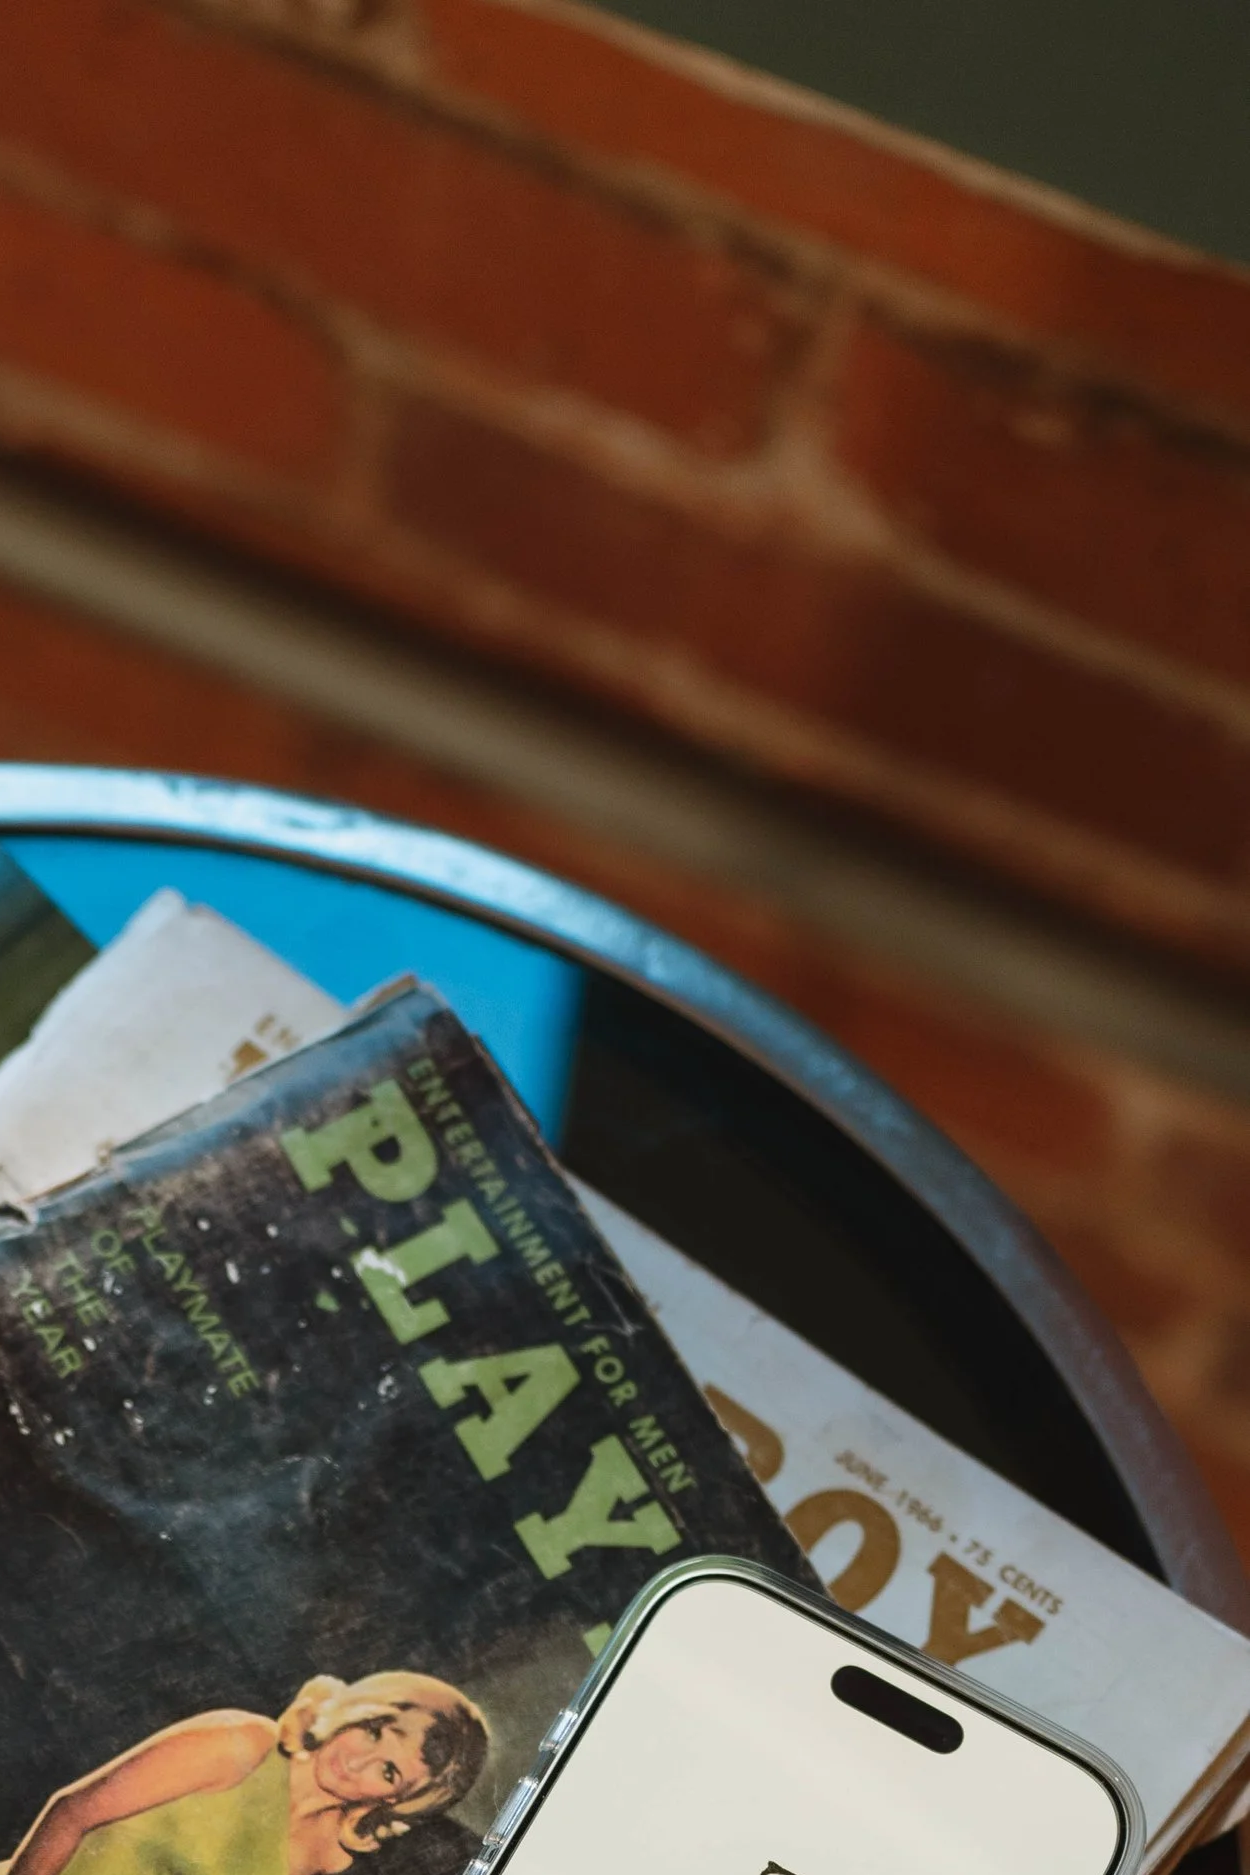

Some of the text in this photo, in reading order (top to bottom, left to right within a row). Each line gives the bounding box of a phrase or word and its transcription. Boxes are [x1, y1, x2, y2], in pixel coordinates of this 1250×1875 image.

[10, 1266, 84, 1379] YEAR
[53, 1250, 109, 1327] THE
[91, 1229, 137, 1276] OF
[126, 1206, 261, 1399] PLAYMATE
[407, 1057, 698, 1495] ENTERTAINMENT FOR MEN
[279, 1078, 682, 1658] PLAY
[834, 1449, 1065, 1615] JUNE 1966 75 CENTS
